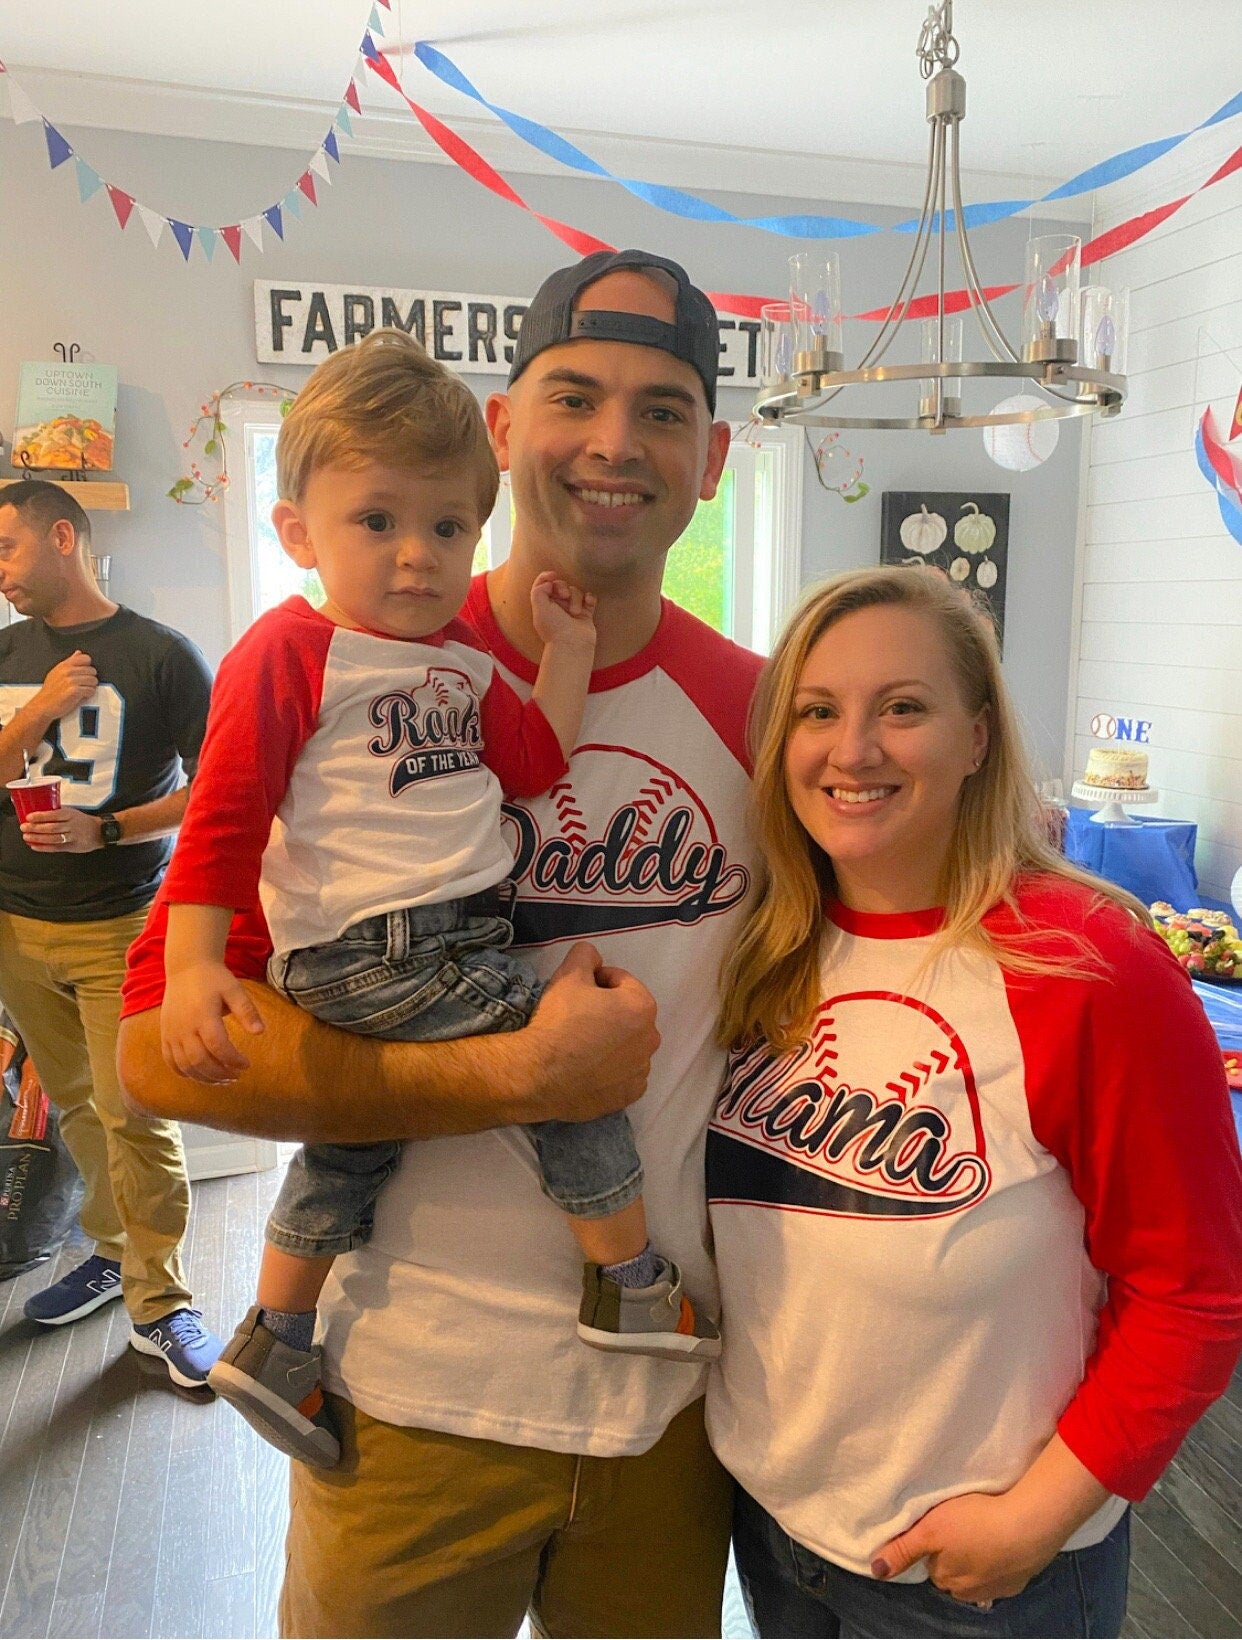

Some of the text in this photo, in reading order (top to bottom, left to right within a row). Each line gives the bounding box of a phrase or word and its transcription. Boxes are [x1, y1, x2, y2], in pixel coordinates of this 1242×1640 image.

[270, 289, 530, 364] FARMERS
[35, 377, 102, 389] DOWN SOUTH
[45, 370, 94, 379] UPTOWN
[46, 386, 89, 397] CUISINE
[406, 757, 427, 775] OF
[431, 753, 456, 772] THE
[14, 1153, 31, 1190] PLAN
[7, 1191, 23, 1220] PRO
